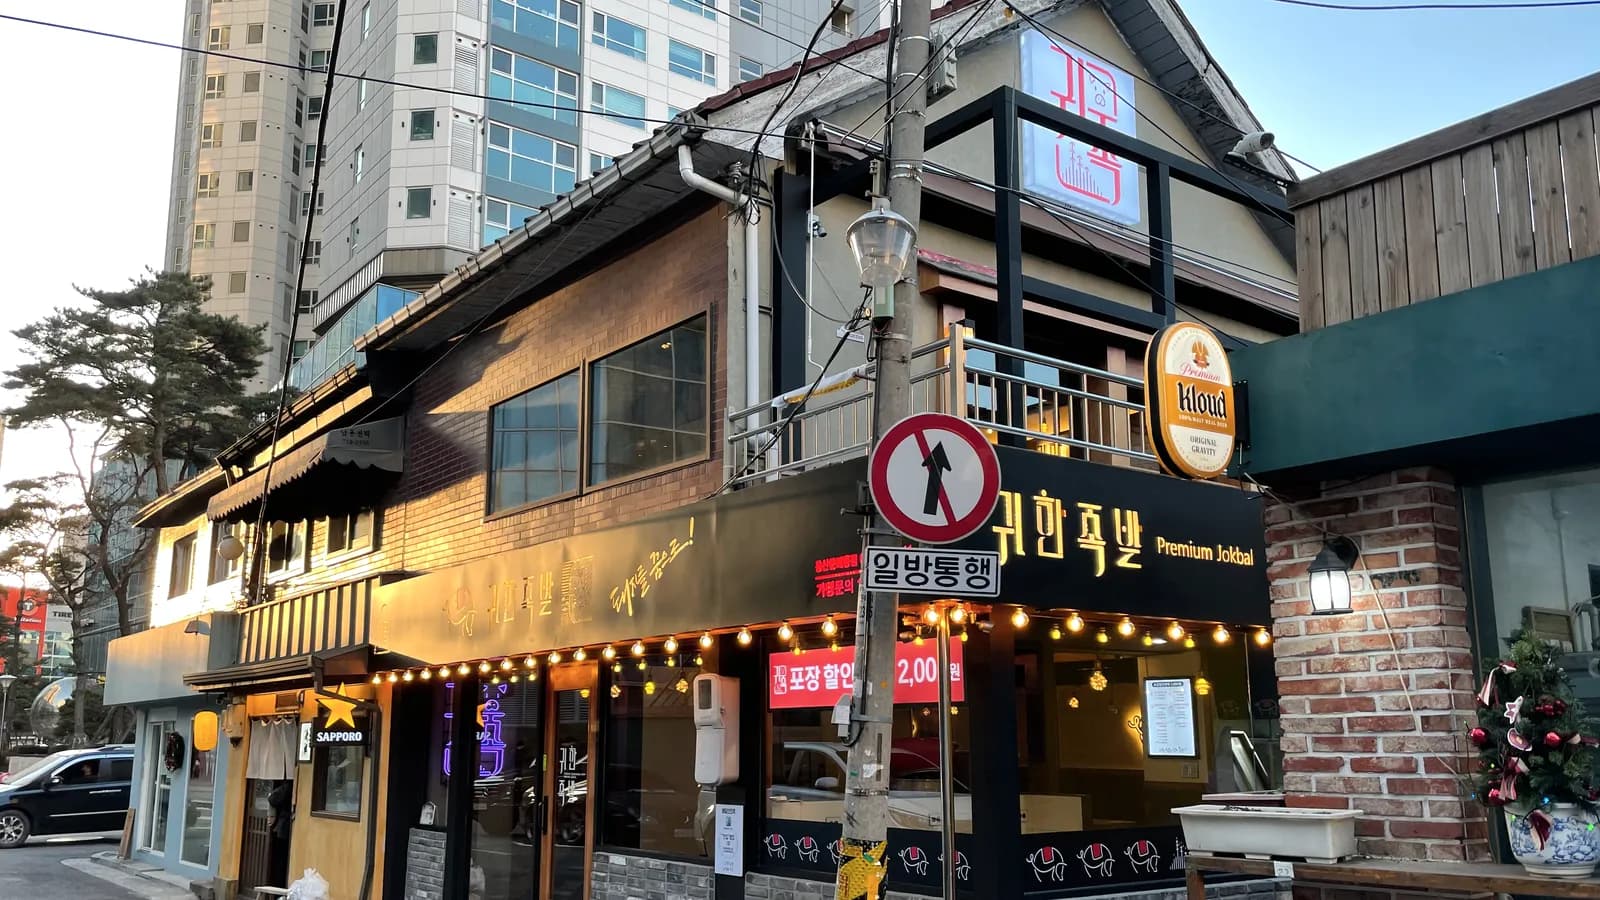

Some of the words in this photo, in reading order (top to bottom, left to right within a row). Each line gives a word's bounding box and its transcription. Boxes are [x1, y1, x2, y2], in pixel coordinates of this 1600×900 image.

[1179, 362, 1221, 382] Premium
[1177, 382, 1227, 419] Kloud
[1189, 434, 1217, 447] ORIGINAL
[1191, 444, 1217, 457] GRAVITY
[992, 489, 1144, 577] 귀한족발
[1156, 536, 1214, 562] Premium
[1216, 543, 1255, 567] Jokbal
[873, 552, 991, 589] 일방통행
[789, 665, 821, 692] 포장
[823, 662, 855, 691] 할인
[316, 731, 362, 742] SAPPORO
